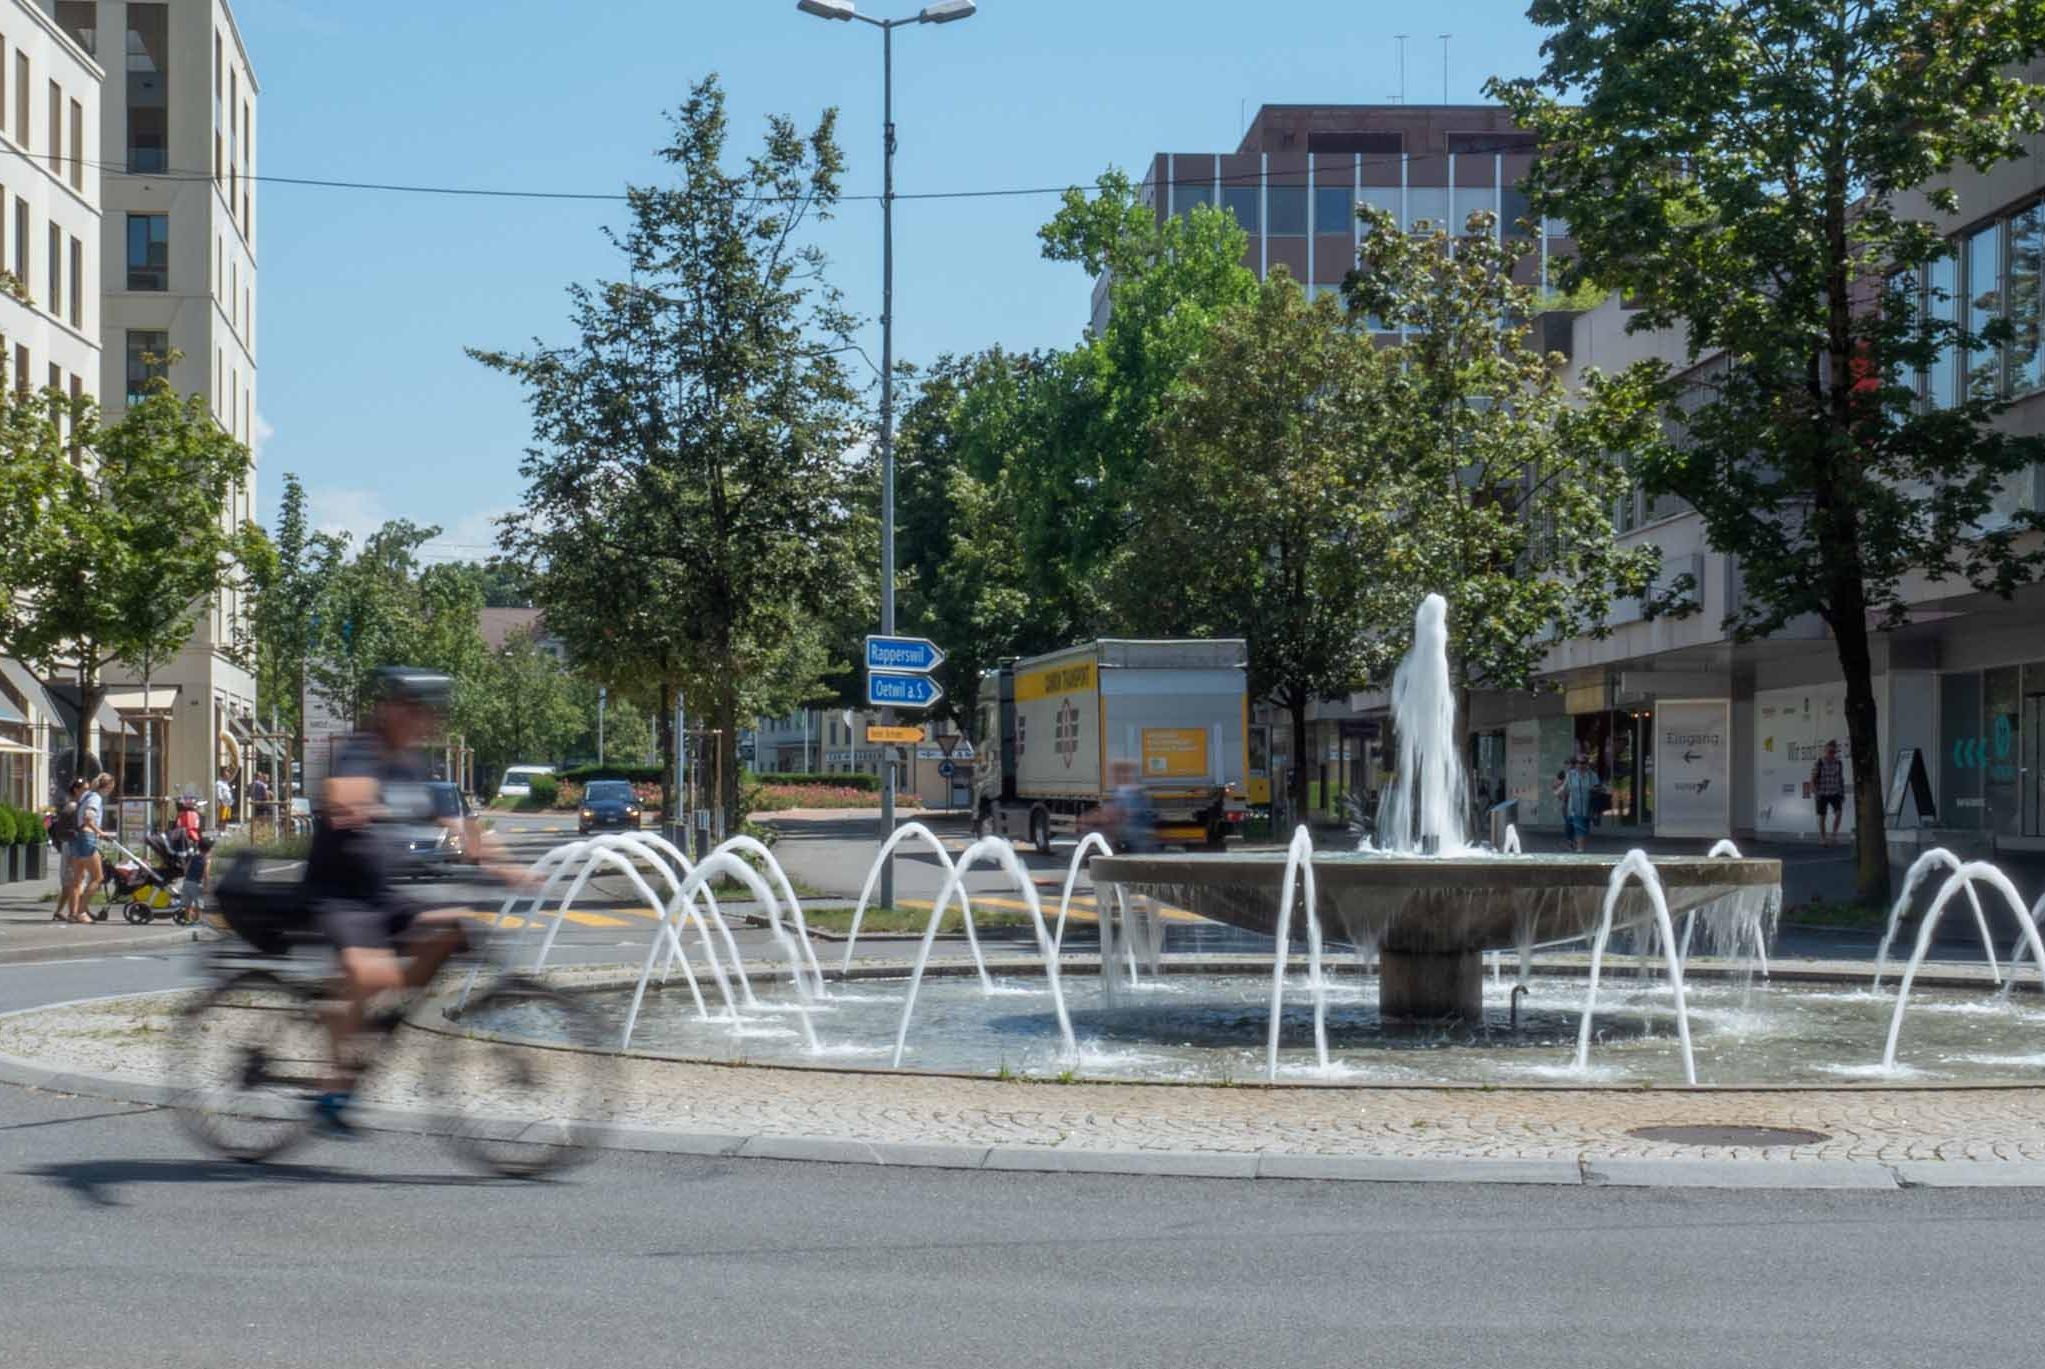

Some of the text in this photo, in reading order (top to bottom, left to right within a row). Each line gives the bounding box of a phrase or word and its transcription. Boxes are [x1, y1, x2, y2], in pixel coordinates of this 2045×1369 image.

[871, 643, 924, 665] Rapperswil
[876, 680, 906, 697] Oetwil
[1666, 732, 1720, 747] Eingang
